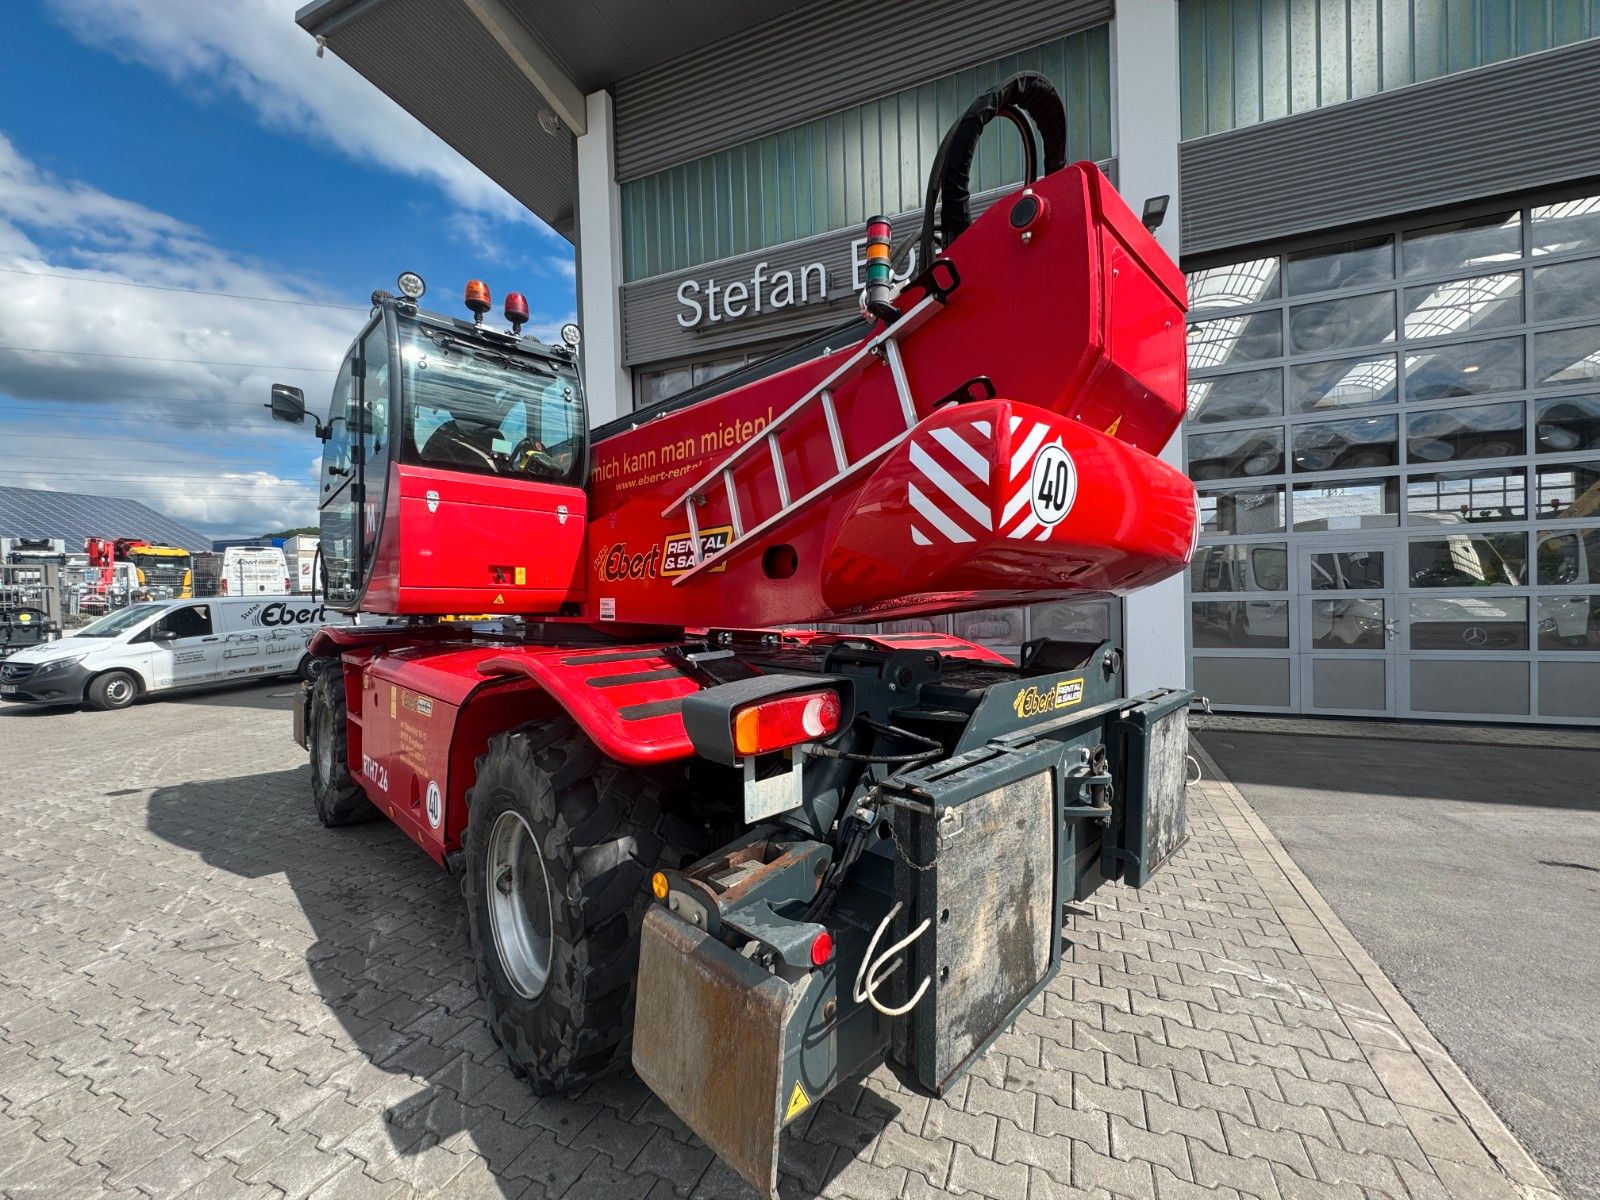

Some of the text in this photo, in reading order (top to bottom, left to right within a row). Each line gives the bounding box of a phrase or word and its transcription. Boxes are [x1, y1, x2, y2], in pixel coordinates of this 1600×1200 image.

[676, 261, 827, 328] Stefan
[591, 455, 620, 483] mich
[623, 449, 656, 475] kann
[661, 438, 695, 465] man
[1038, 457, 1069, 512] 40
[606, 542, 661, 582] Ebert
[665, 557, 676, 569] &
[261, 602, 326, 627] Ebert
[1023, 686, 1056, 717] Ebert
[428, 788, 439, 820] 40
